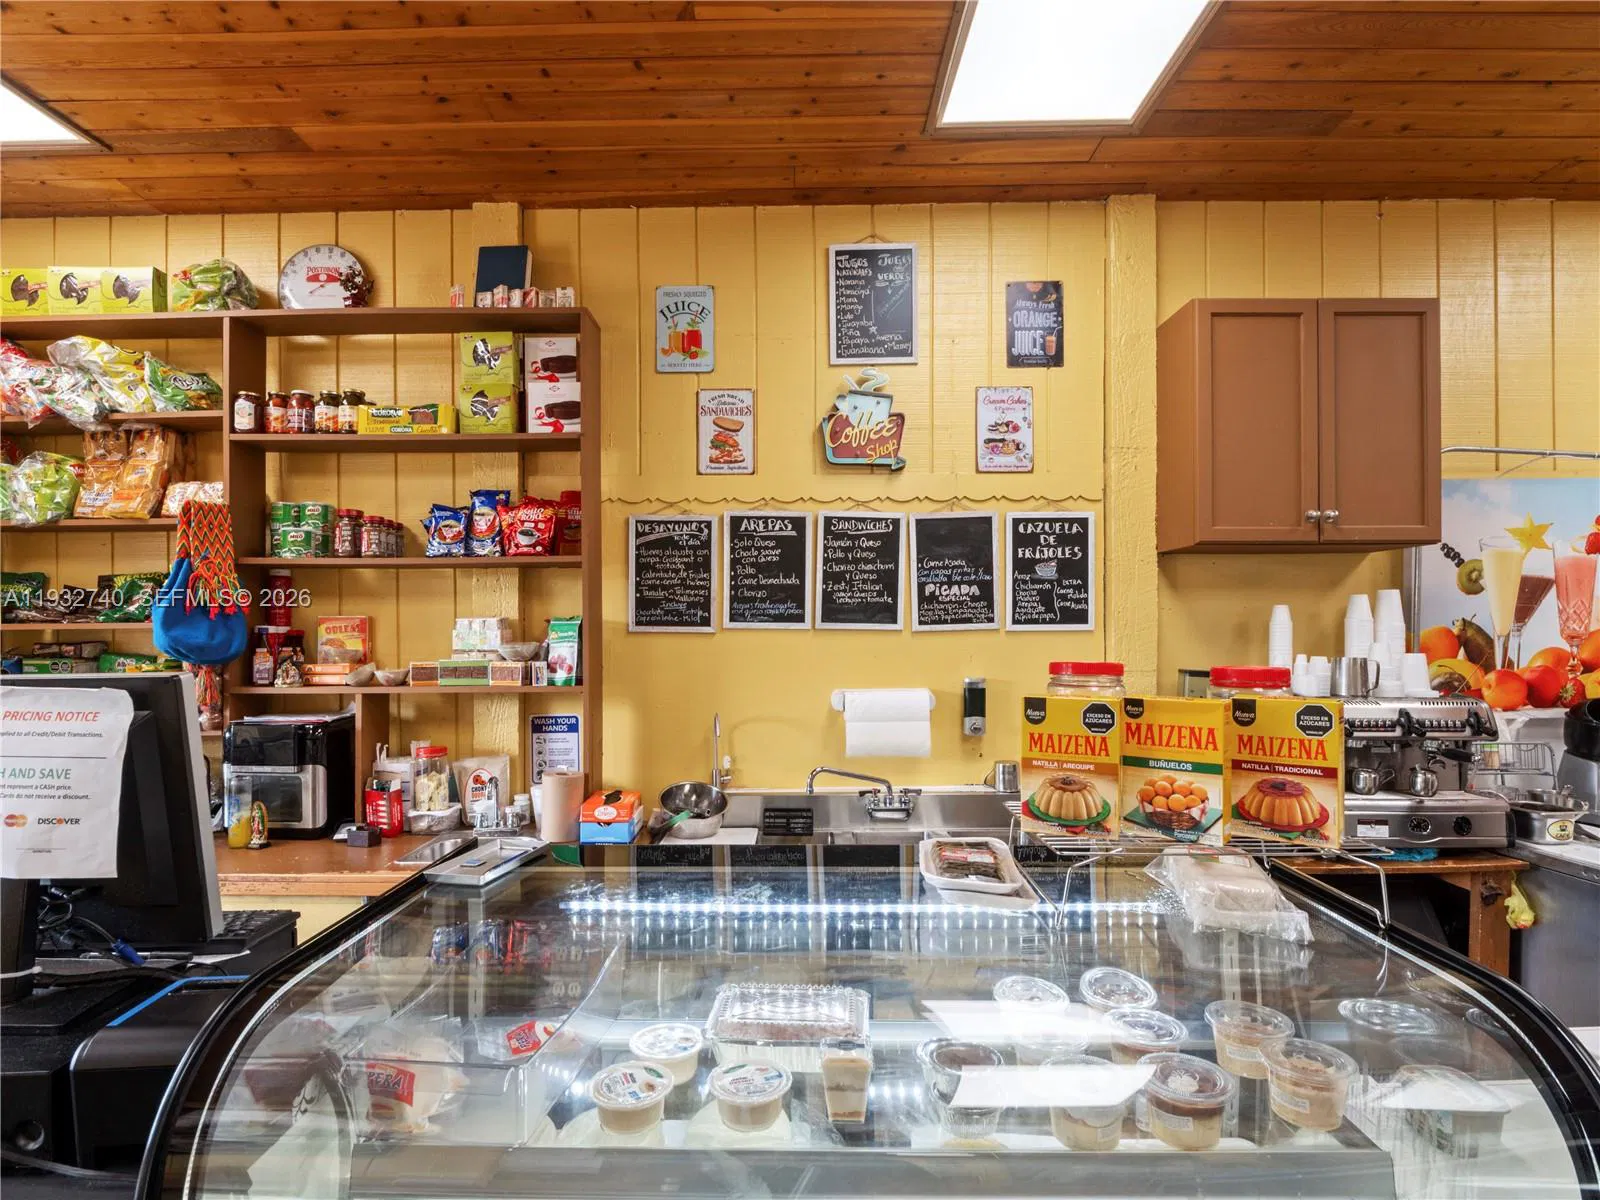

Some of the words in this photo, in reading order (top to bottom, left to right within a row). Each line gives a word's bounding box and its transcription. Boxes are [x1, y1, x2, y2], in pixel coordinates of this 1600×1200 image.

[659, 300, 711, 323] JUICE
[1013, 310, 1058, 328] ORANGE
[1012, 330, 1045, 356] JUICE
[700, 405, 752, 417] SANDWICHES
[865, 440, 899, 468] Shop
[636, 522, 708, 534] DESAYUNOS
[740, 518, 793, 532] AREPAS
[831, 518, 893, 532] SANDWICHES
[1018, 522, 1084, 534] CAZUELA
[734, 537, 753, 548] Solo
[753, 537, 776, 547] Queso
[859, 537, 882, 548] Queso
[1040, 534, 1058, 546] DE
[757, 555, 780, 563] Queso
[827, 549, 845, 559] Pollo
[853, 549, 877, 559] Queso
[736, 565, 756, 575] Pollo
[852, 570, 878, 580] Queso
[851, 580, 883, 591] Italian
[2, 710, 53, 722] PRICING
[54, 711, 101, 722] NOTICE
[556, 717, 577, 725] YOUR
[1124, 721, 1219, 752] MAIZENA
[1028, 732, 1110, 757] MAIZENA
[1236, 734, 1328, 761] MAIZENA
[1032, 760, 1058, 768] NATILLA
[1062, 761, 1095, 770] AREQUIPE
[1149, 759, 1193, 771] BUÑUELOS
[1241, 762, 1270, 770] NATILLA
[1275, 765, 1324, 776] TRADICIONAL
[8, 767, 36, 779] AND
[39, 768, 72, 780] SAVE
[37, 817, 81, 825] DISCOVER
